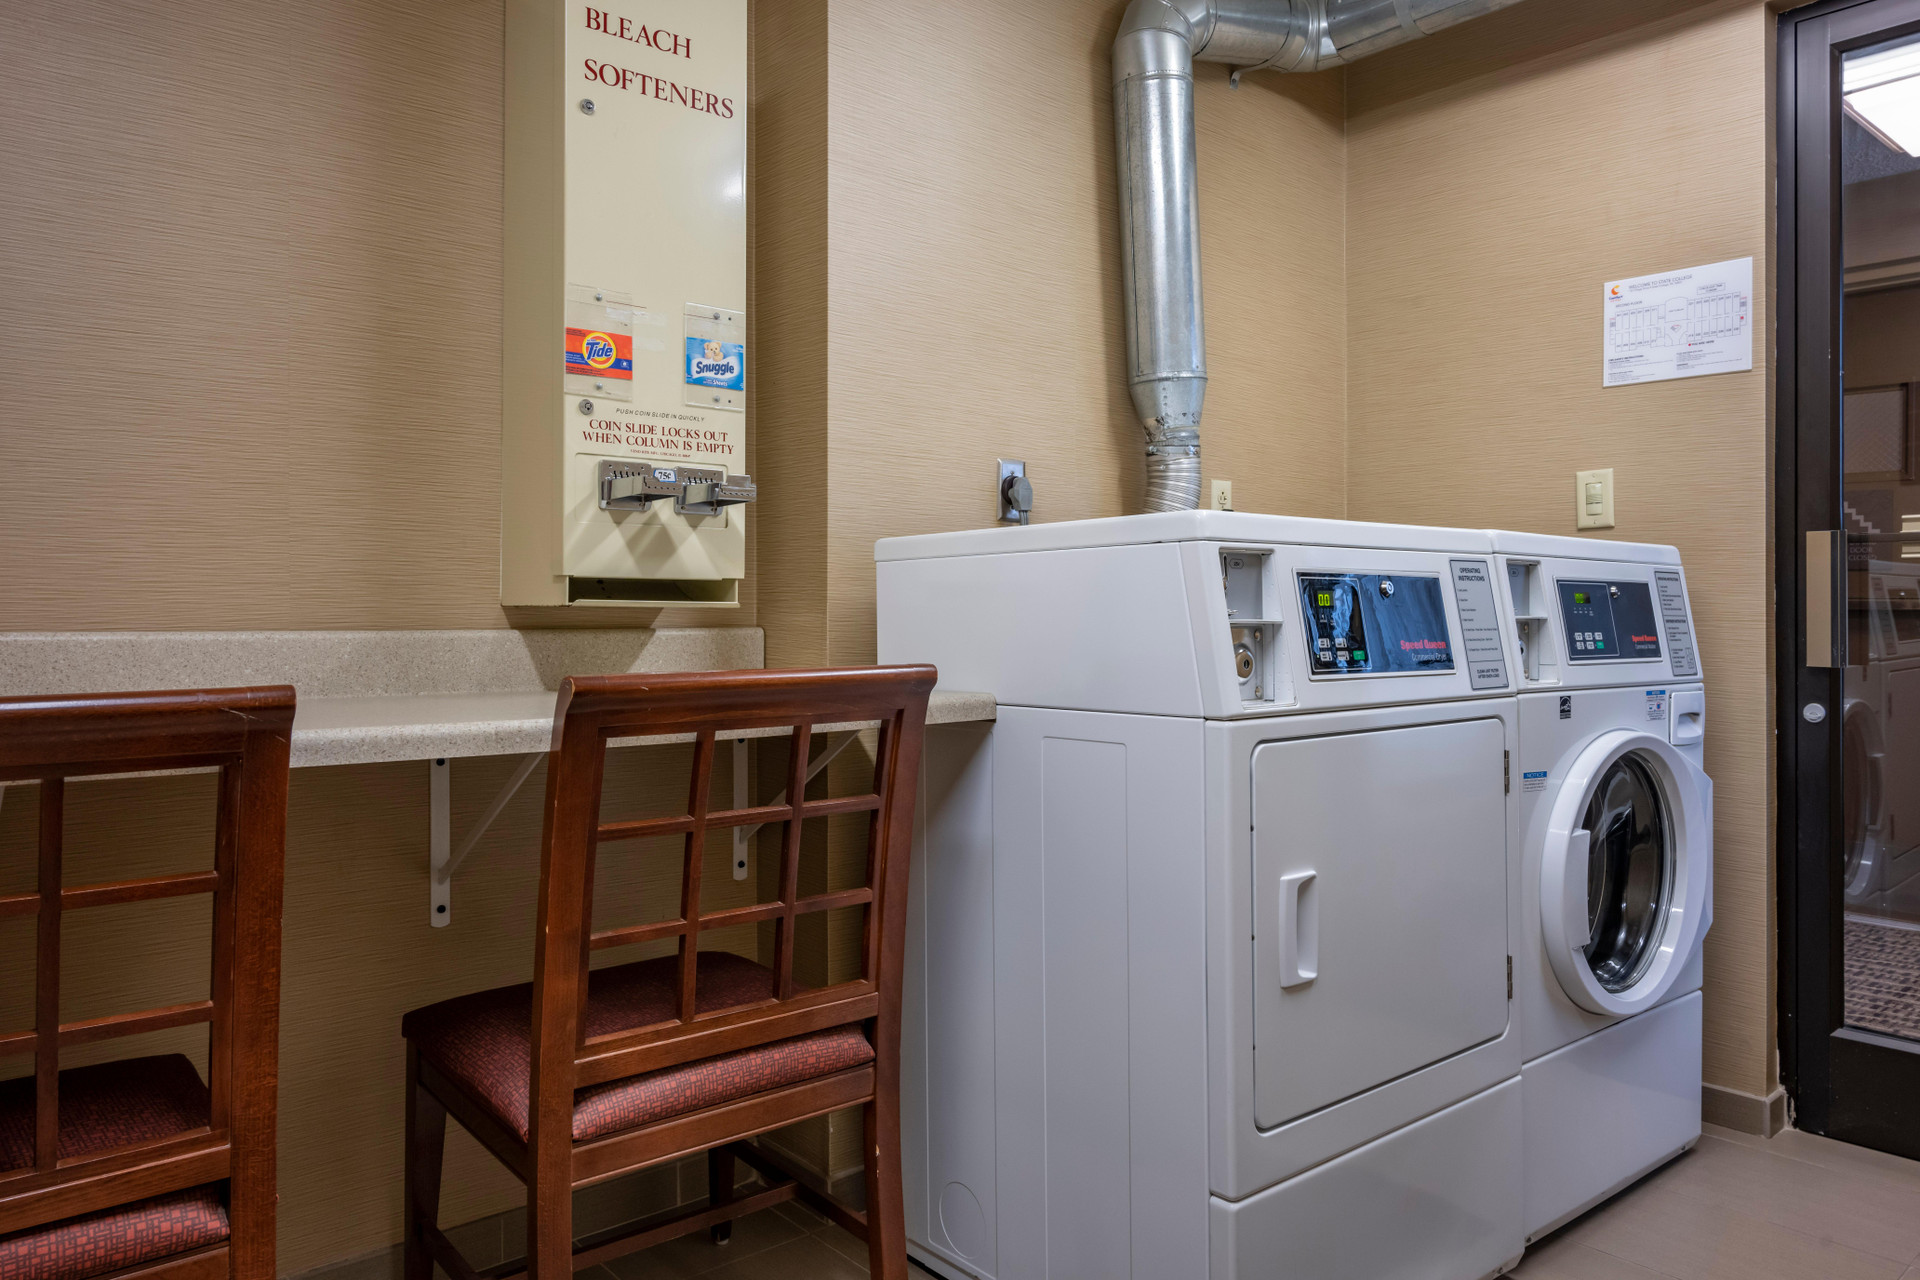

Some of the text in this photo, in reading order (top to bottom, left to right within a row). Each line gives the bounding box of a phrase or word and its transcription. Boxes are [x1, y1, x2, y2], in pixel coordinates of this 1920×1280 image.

[585, 6, 692, 59] BLEACH
[584, 58, 734, 119] SOFTENERS
[585, 341, 613, 361] Tide
[695, 360, 735, 376] Snuggle
[616, 407, 634, 415] PUSH
[651, 411, 670, 419] SLIDE
[677, 414, 705, 422] QUICKLY
[589, 418, 728, 442] COIN SLIDE LOCKS OUT
[582, 431, 734, 455] WHEN COLUMN IS EMPTY
[1401, 639, 1446, 651] Speed Queen
